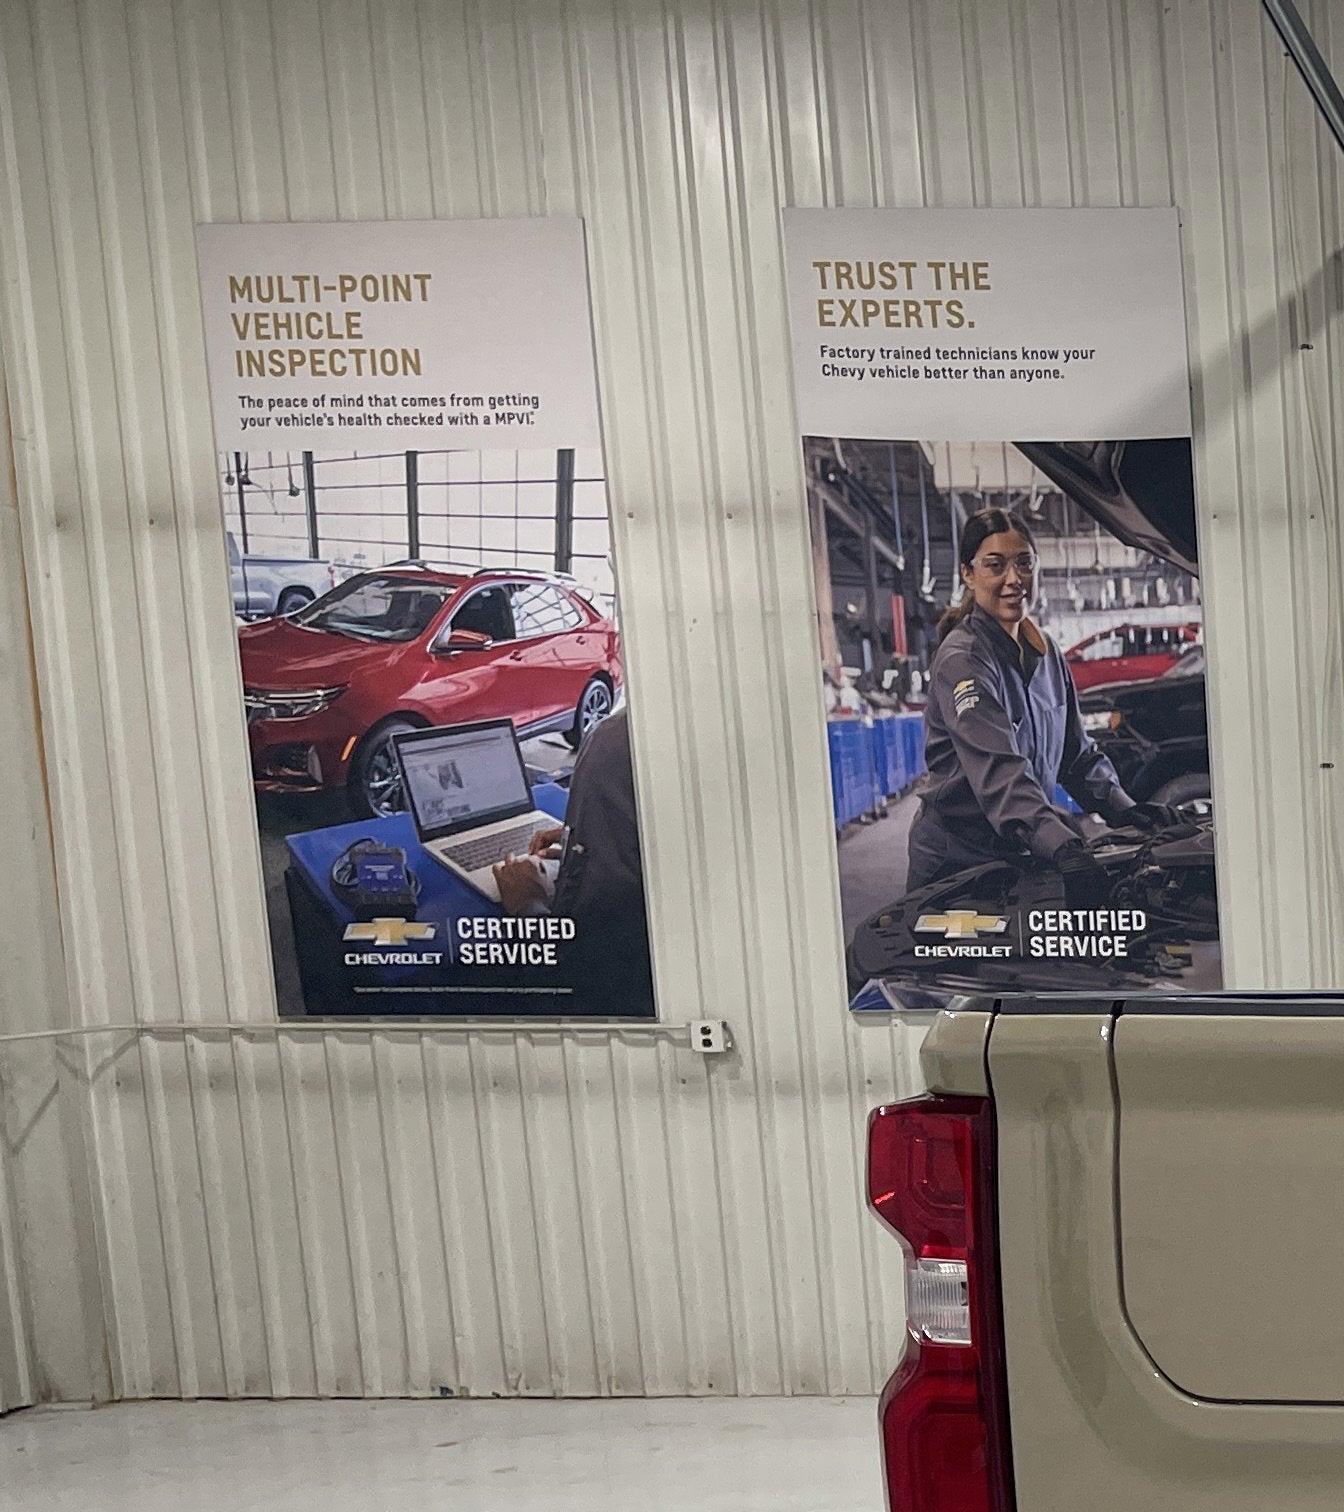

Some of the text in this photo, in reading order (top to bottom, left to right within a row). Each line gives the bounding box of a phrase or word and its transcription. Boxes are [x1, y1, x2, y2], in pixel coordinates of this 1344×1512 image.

[813, 261, 991, 291] TRUST THE
[228, 273, 432, 304] MULTI-POINT
[817, 299, 976, 329] EXPERTS.
[231, 312, 364, 341] VEHICLE
[235, 348, 422, 378] INSPECTION
[820, 345, 1096, 362] Factory trained technicians know your
[822, 364, 1065, 382] Chevy vehicle better than anyone.
[239, 394, 539, 412] The peace of mind that comes from getting
[240, 416, 270, 430] your
[275, 413, 334, 426] vehicle's
[338, 413, 382, 426] health
[386, 412, 443, 426] checked
[448, 412, 478, 425] with
[483, 416, 490, 425] a
[457, 917, 576, 940] CERTIFIED
[1028, 909, 1146, 932] CERTIFIED
[459, 943, 558, 965] SERVICE
[914, 945, 1013, 958] CHEVROLET
[1029, 935, 1128, 957] SERVICE
[344, 952, 442, 965] CHEVROLET
